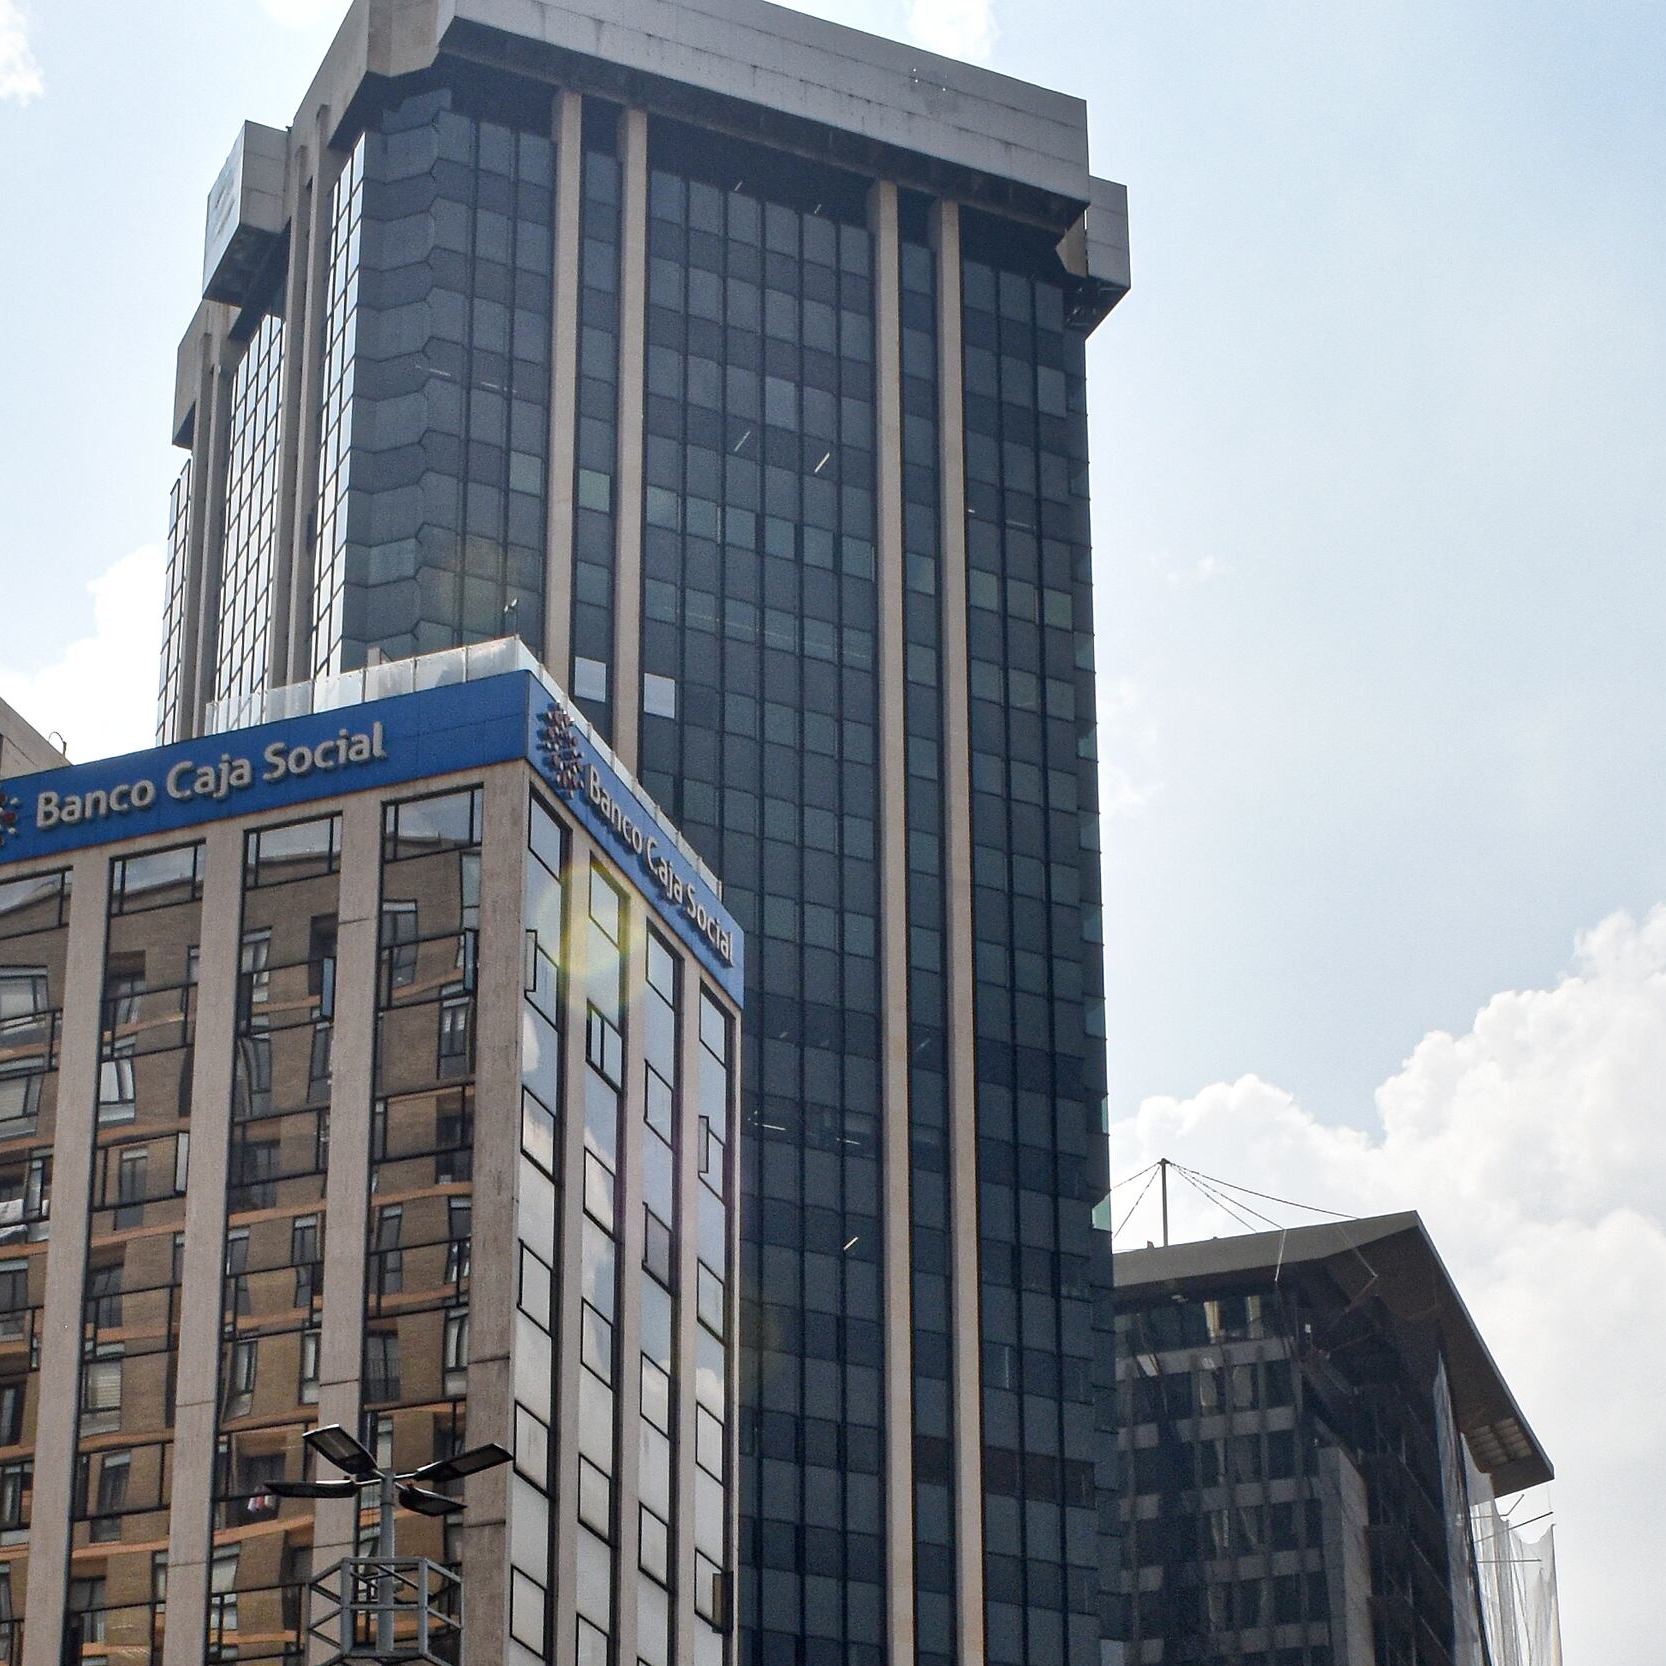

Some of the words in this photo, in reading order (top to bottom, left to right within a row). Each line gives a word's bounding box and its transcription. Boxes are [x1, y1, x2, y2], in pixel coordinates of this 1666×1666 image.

[36, 778, 156, 829] Banco
[166, 753, 253, 801] Caja
[263, 721, 387, 781] Social
[587, 763, 643, 854] Banco
[645, 836, 684, 905] Caja
[686, 882, 734, 968] Social
